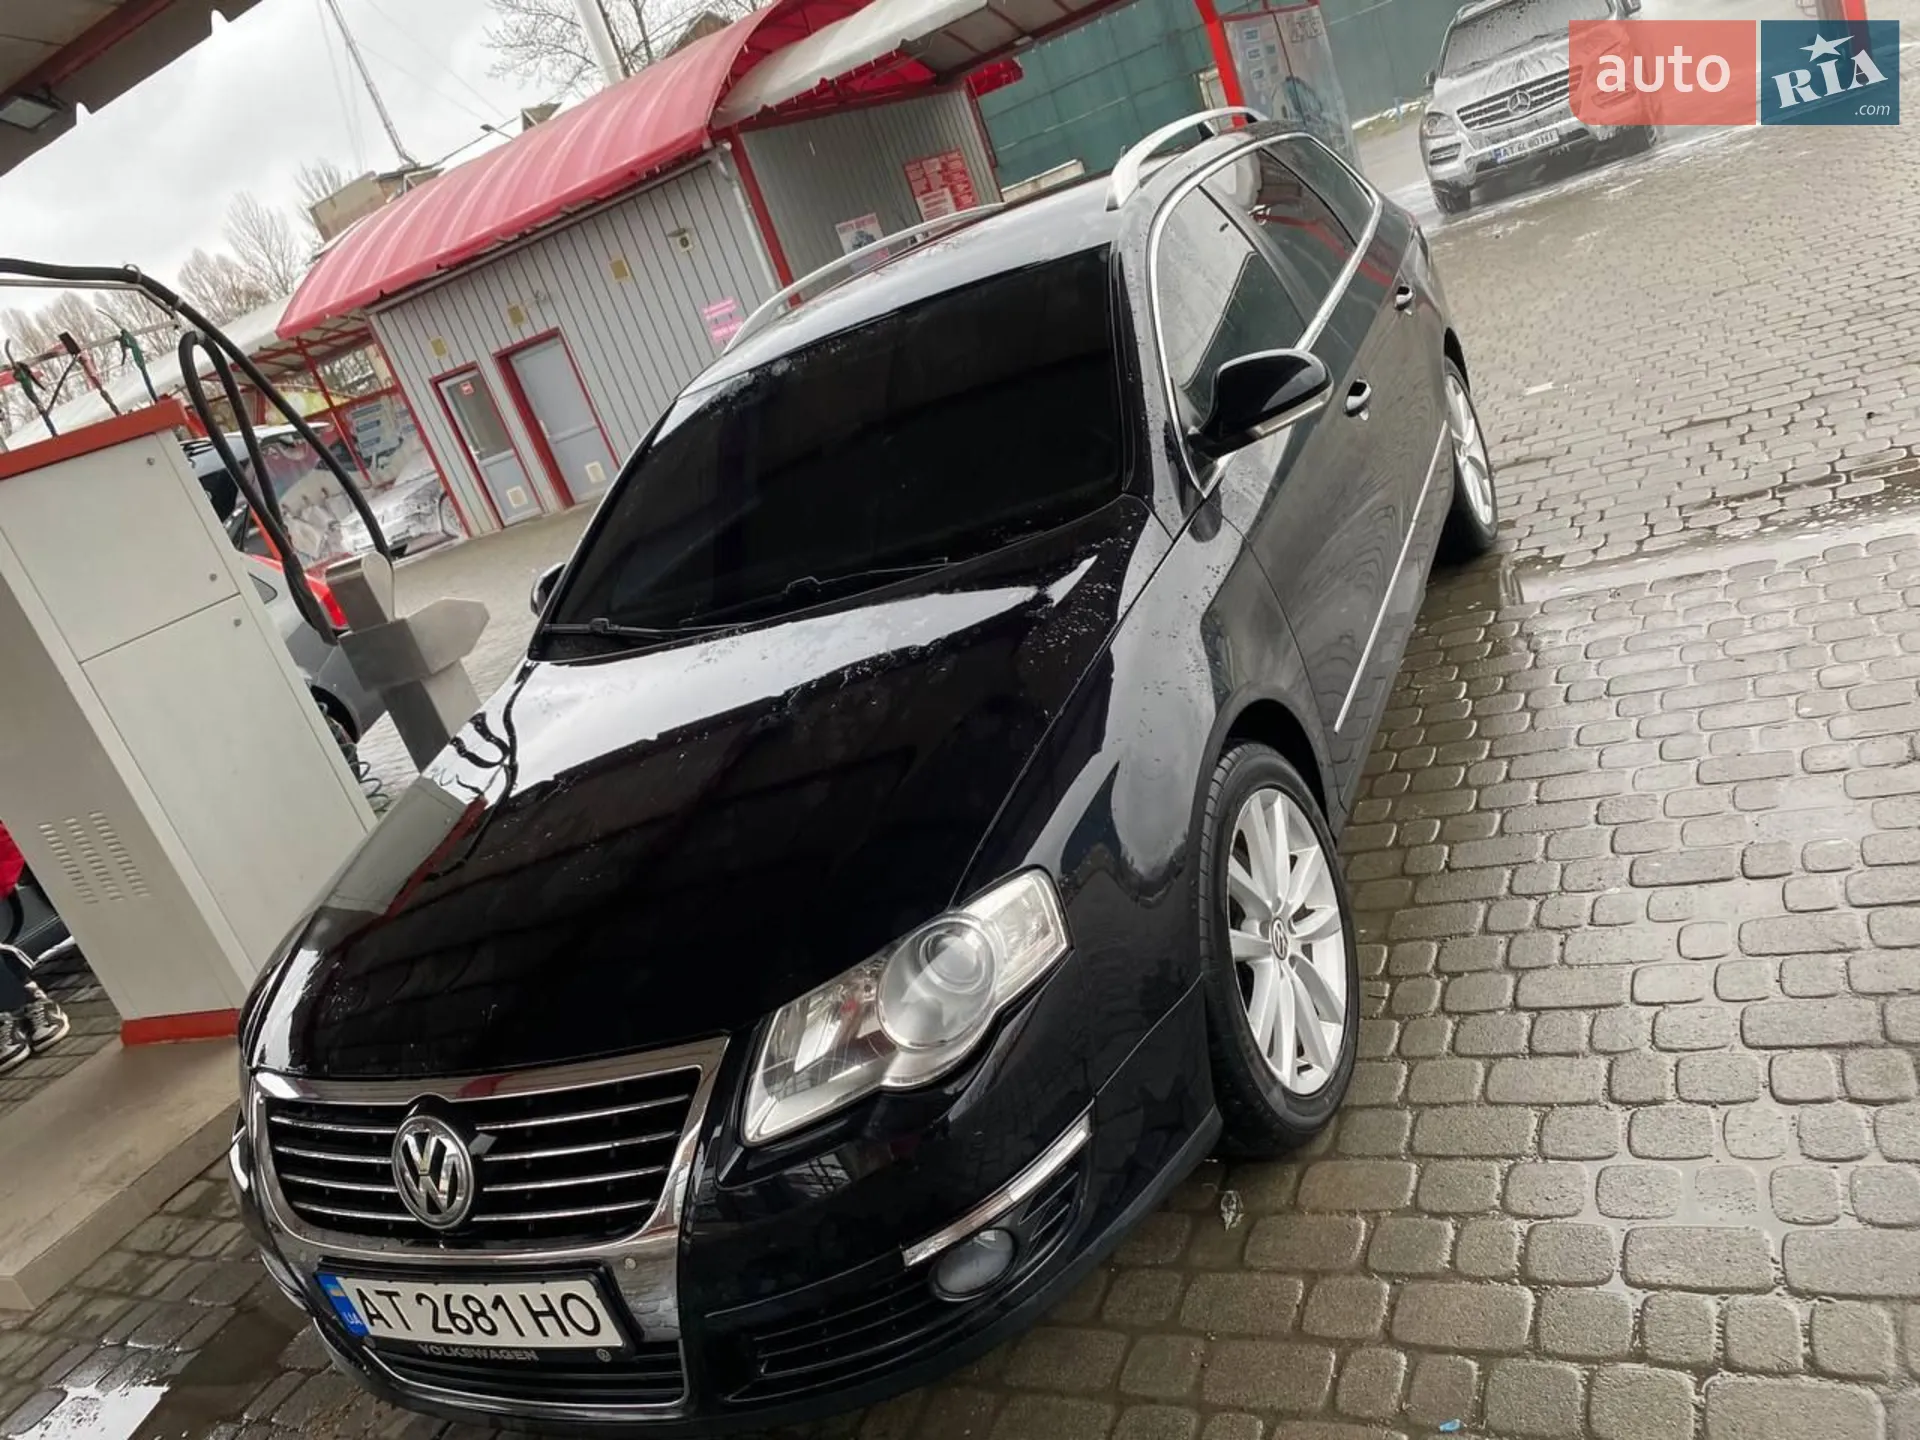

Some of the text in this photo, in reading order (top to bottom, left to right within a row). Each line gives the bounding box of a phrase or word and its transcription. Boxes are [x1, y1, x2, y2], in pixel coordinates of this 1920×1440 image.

[356, 1287, 601, 1338] AT 2681 HO
[417, 1343, 539, 1361] VOLKSWAGEN
